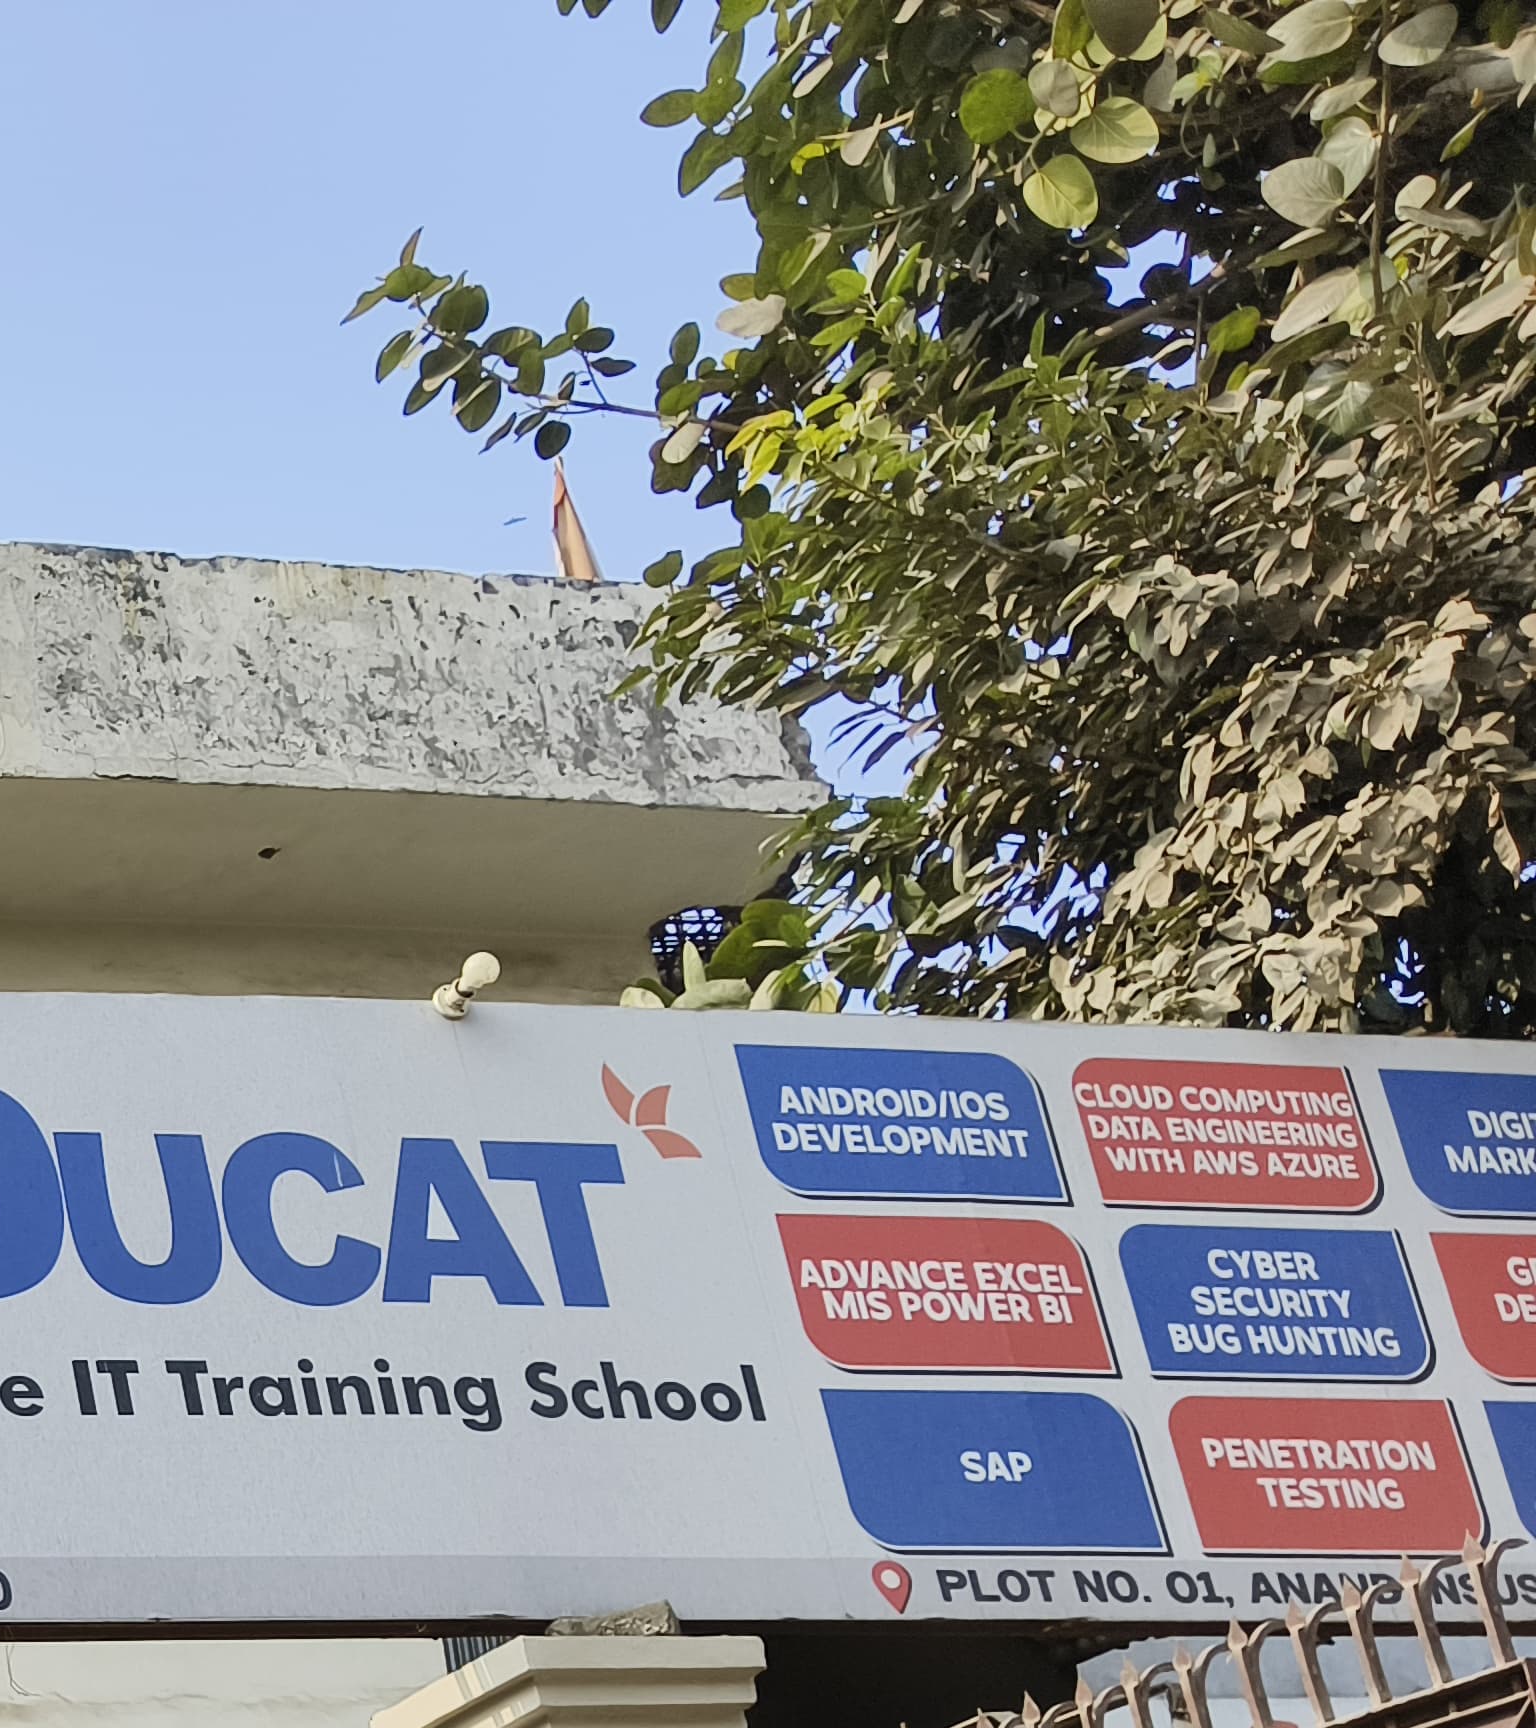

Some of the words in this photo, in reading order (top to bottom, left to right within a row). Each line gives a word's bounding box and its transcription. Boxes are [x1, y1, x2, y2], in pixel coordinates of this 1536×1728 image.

[779, 1084, 1011, 1122] ANDROID/IOS
[1074, 1080, 1174, 1113] CLOUD
[1180, 1084, 1355, 1119] COMPUTING
[773, 1121, 1030, 1160] DEVELOPMENT
[1088, 1113, 1162, 1143] DATA
[1169, 1116, 1358, 1151] ENGINEERING
[1103, 1145, 1187, 1175] WITH
[1191, 1148, 1261, 1179] AWS
[1267, 1151, 1360, 1181] AZURE
[799, 1257, 966, 1291] ADVANCE
[976, 1260, 1082, 1295] EXCEL
[1206, 1248, 1320, 1281] CYBER
[823, 1288, 893, 1321] MIS
[901, 1290, 1032, 1323] POWER
[1040, 1293, 1074, 1324] BI
[1190, 1284, 1352, 1318] SECURITY
[1167, 1323, 1244, 1355] BUG
[1246, 1324, 1402, 1359] HUNTING
[71, 1359, 140, 1418] IT
[165, 1357, 504, 1432] Training
[526, 1359, 767, 1423] School
[959, 1449, 1033, 1484] SAP
[1201, 1437, 1438, 1472] PENETRATION
[1255, 1477, 1406, 1512] TESTING
[936, 1568, 1054, 1603] PLOT
[1072, 1570, 1152, 1603] NO.
[1251, 1571, 1403, 1605] ANAND
